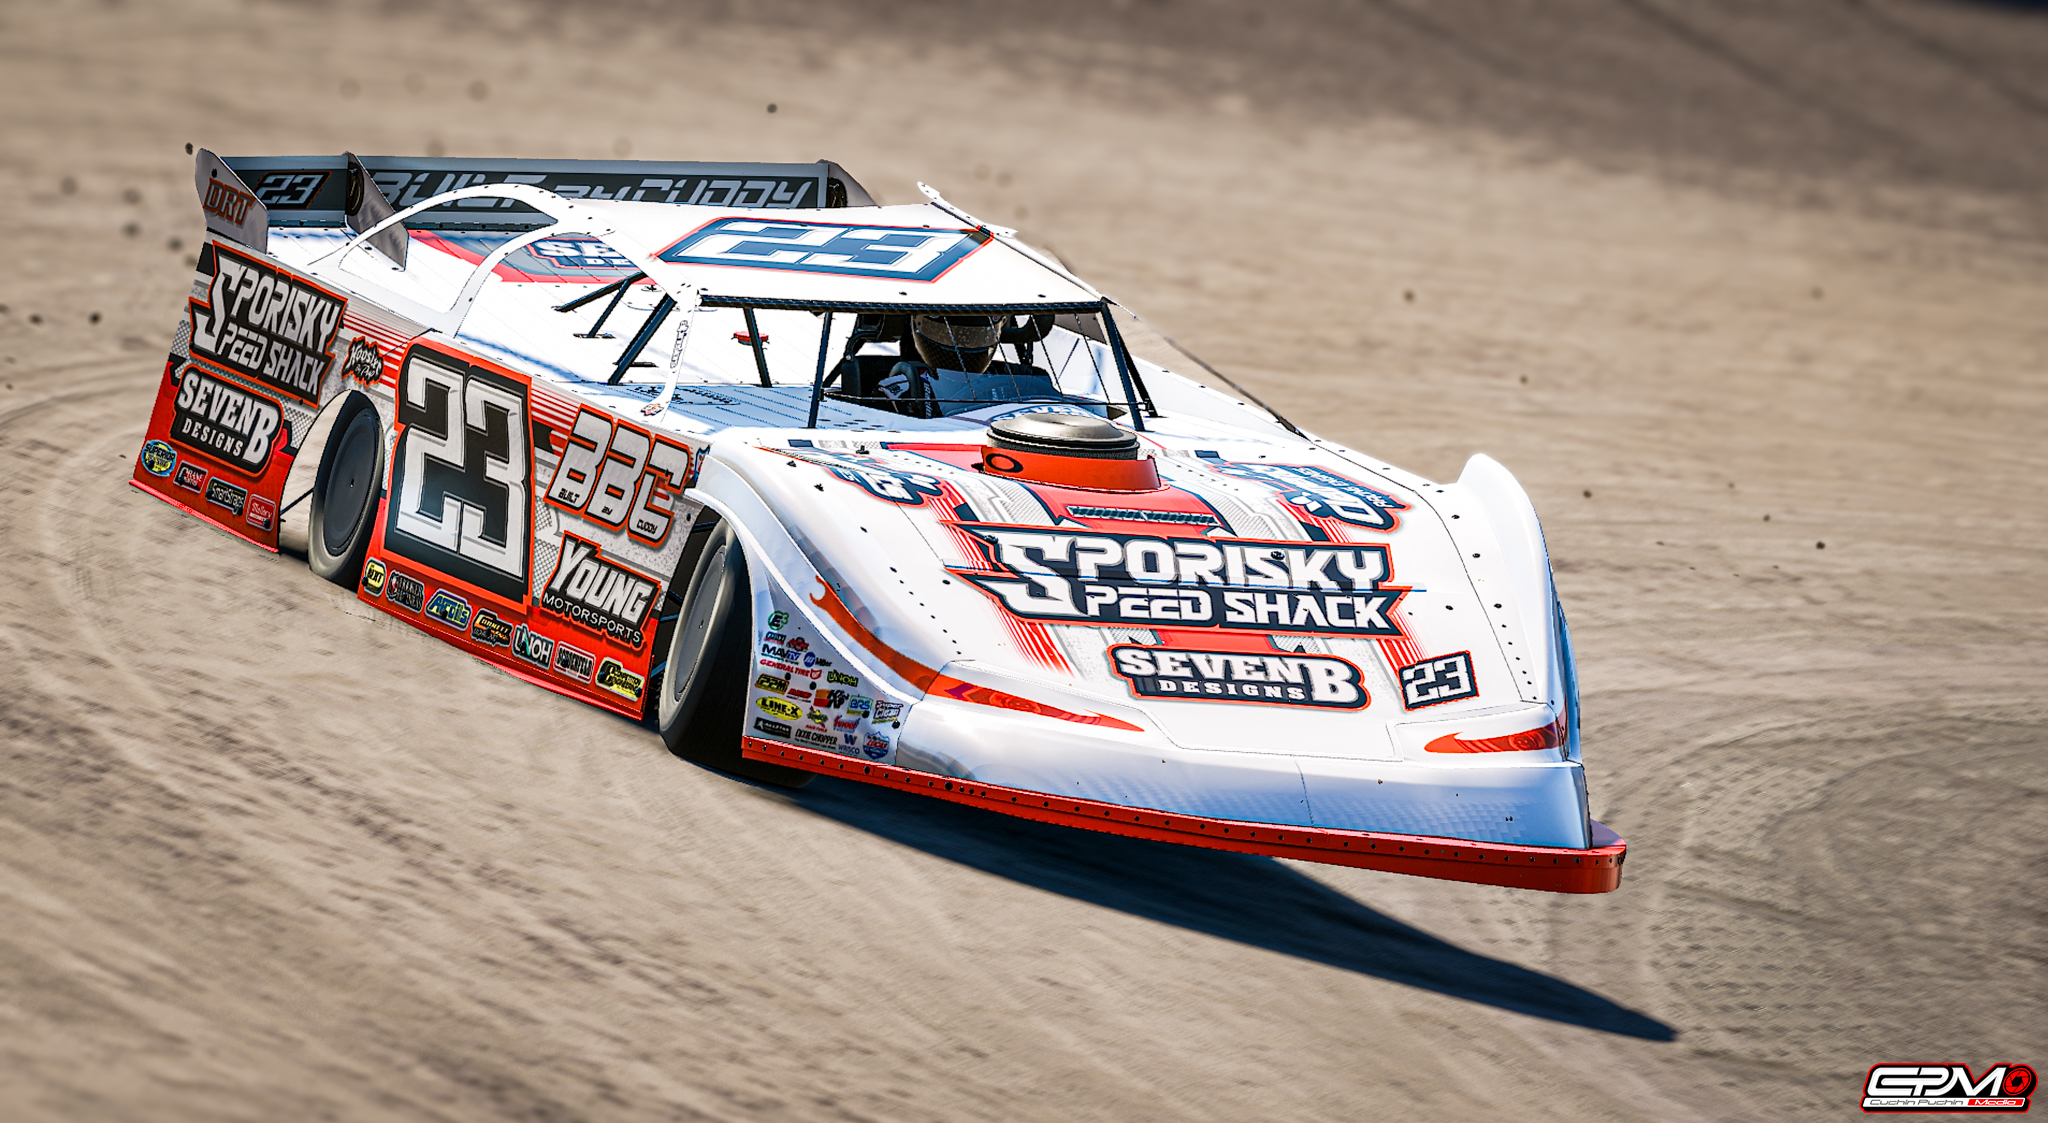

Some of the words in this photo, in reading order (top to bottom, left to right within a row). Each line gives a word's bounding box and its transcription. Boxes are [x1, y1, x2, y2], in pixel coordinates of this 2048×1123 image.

[204, 179, 253, 224] DRT
[255, 174, 324, 204] 23
[672, 221, 974, 274] 23
[191, 258, 341, 357] SPORISKY
[263, 342, 325, 398] SHACK
[144, 443, 176, 462] SUPERIOR
[181, 418, 244, 460] DESIGNS
[396, 357, 524, 579] 23
[547, 407, 691, 541] BBC
[558, 488, 580, 504] BUILT
[550, 536, 658, 625] YOUNG
[965, 535, 1384, 616] SPORISKY
[543, 592, 642, 643] MOTORSPORTS
[1223, 591, 1392, 630] SHACK
[760, 659, 794, 673] GENERAL
[793, 667, 810, 678] TIRE
[1158, 679, 1306, 701] DESIGNS
[1401, 660, 1471, 701] 23
